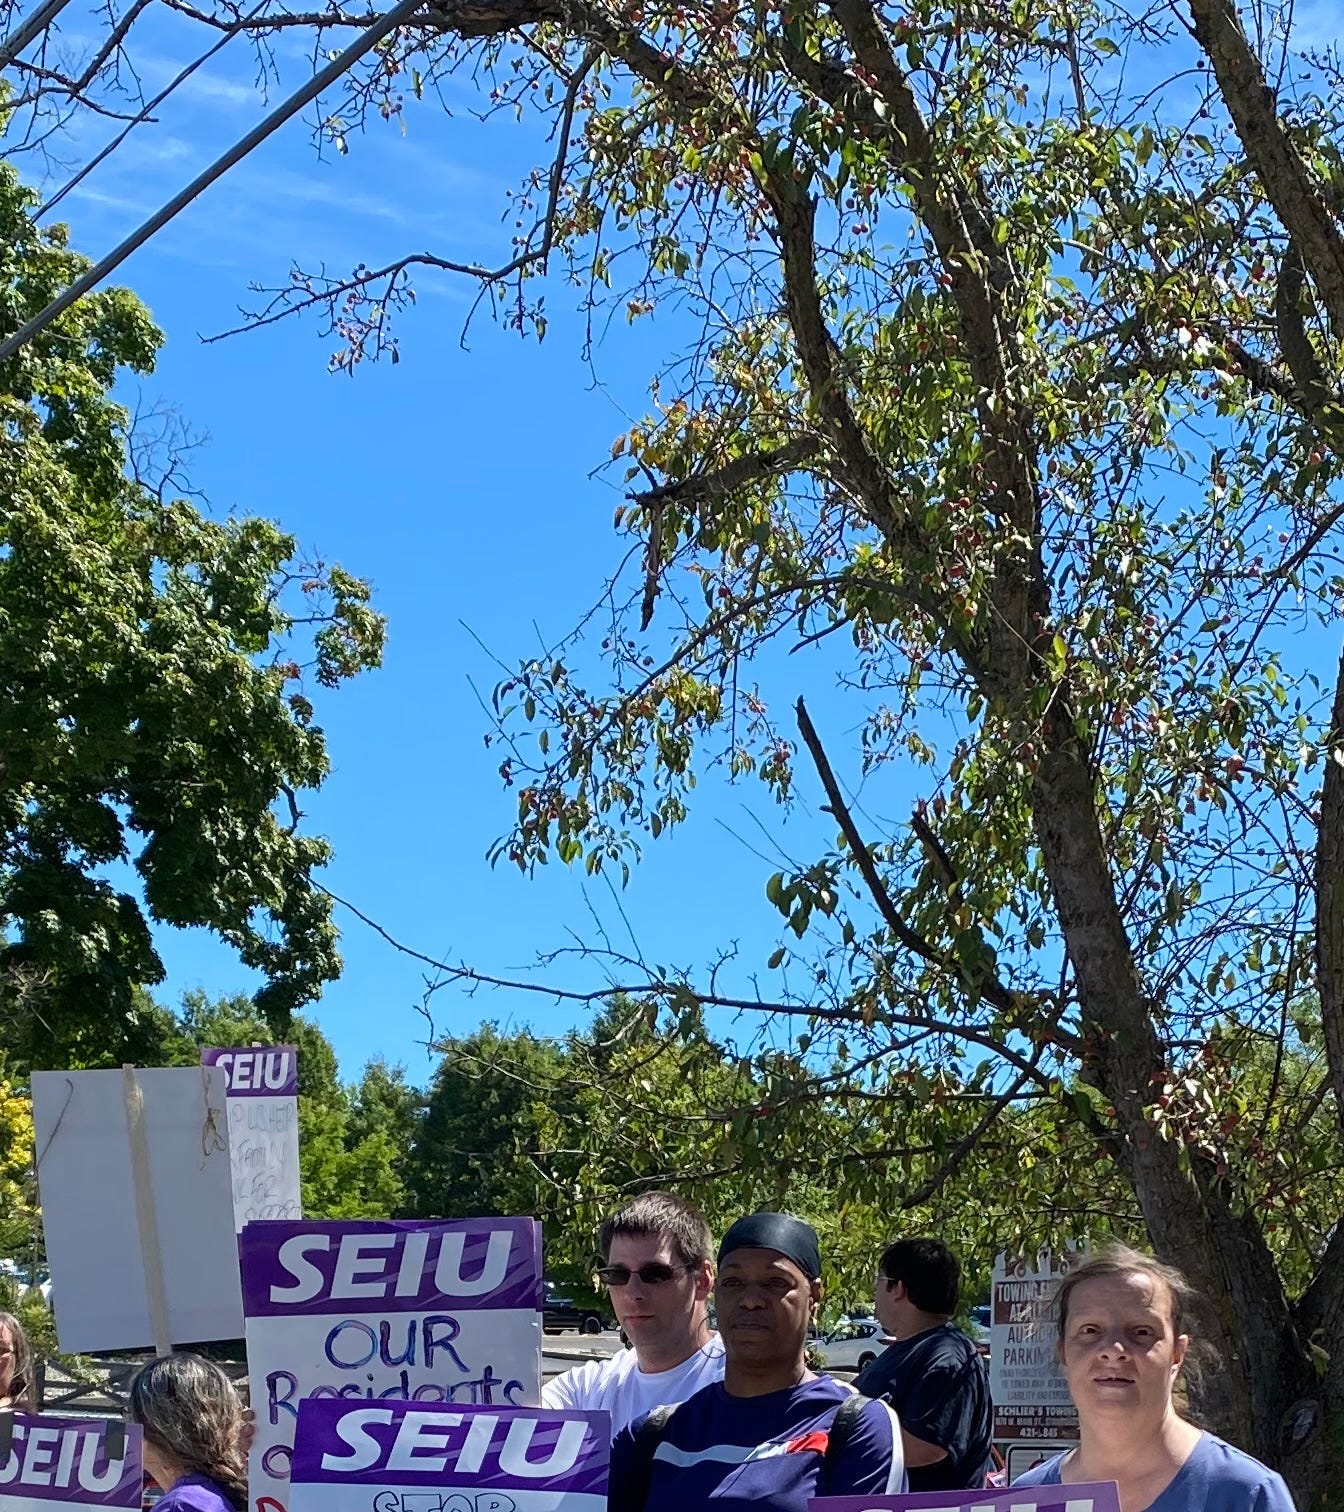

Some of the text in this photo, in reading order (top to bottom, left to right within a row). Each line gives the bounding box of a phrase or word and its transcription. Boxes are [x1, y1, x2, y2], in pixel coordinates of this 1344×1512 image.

[215, 1053, 290, 1090] SEIU
[269, 1230, 514, 1303] SEIU
[998, 1283, 1036, 1303] TOWING
[325, 1315, 470, 1373] OUR
[998, 1406, 1043, 1416] SCHLIER'S
[321, 1408, 589, 1478] SEIU
